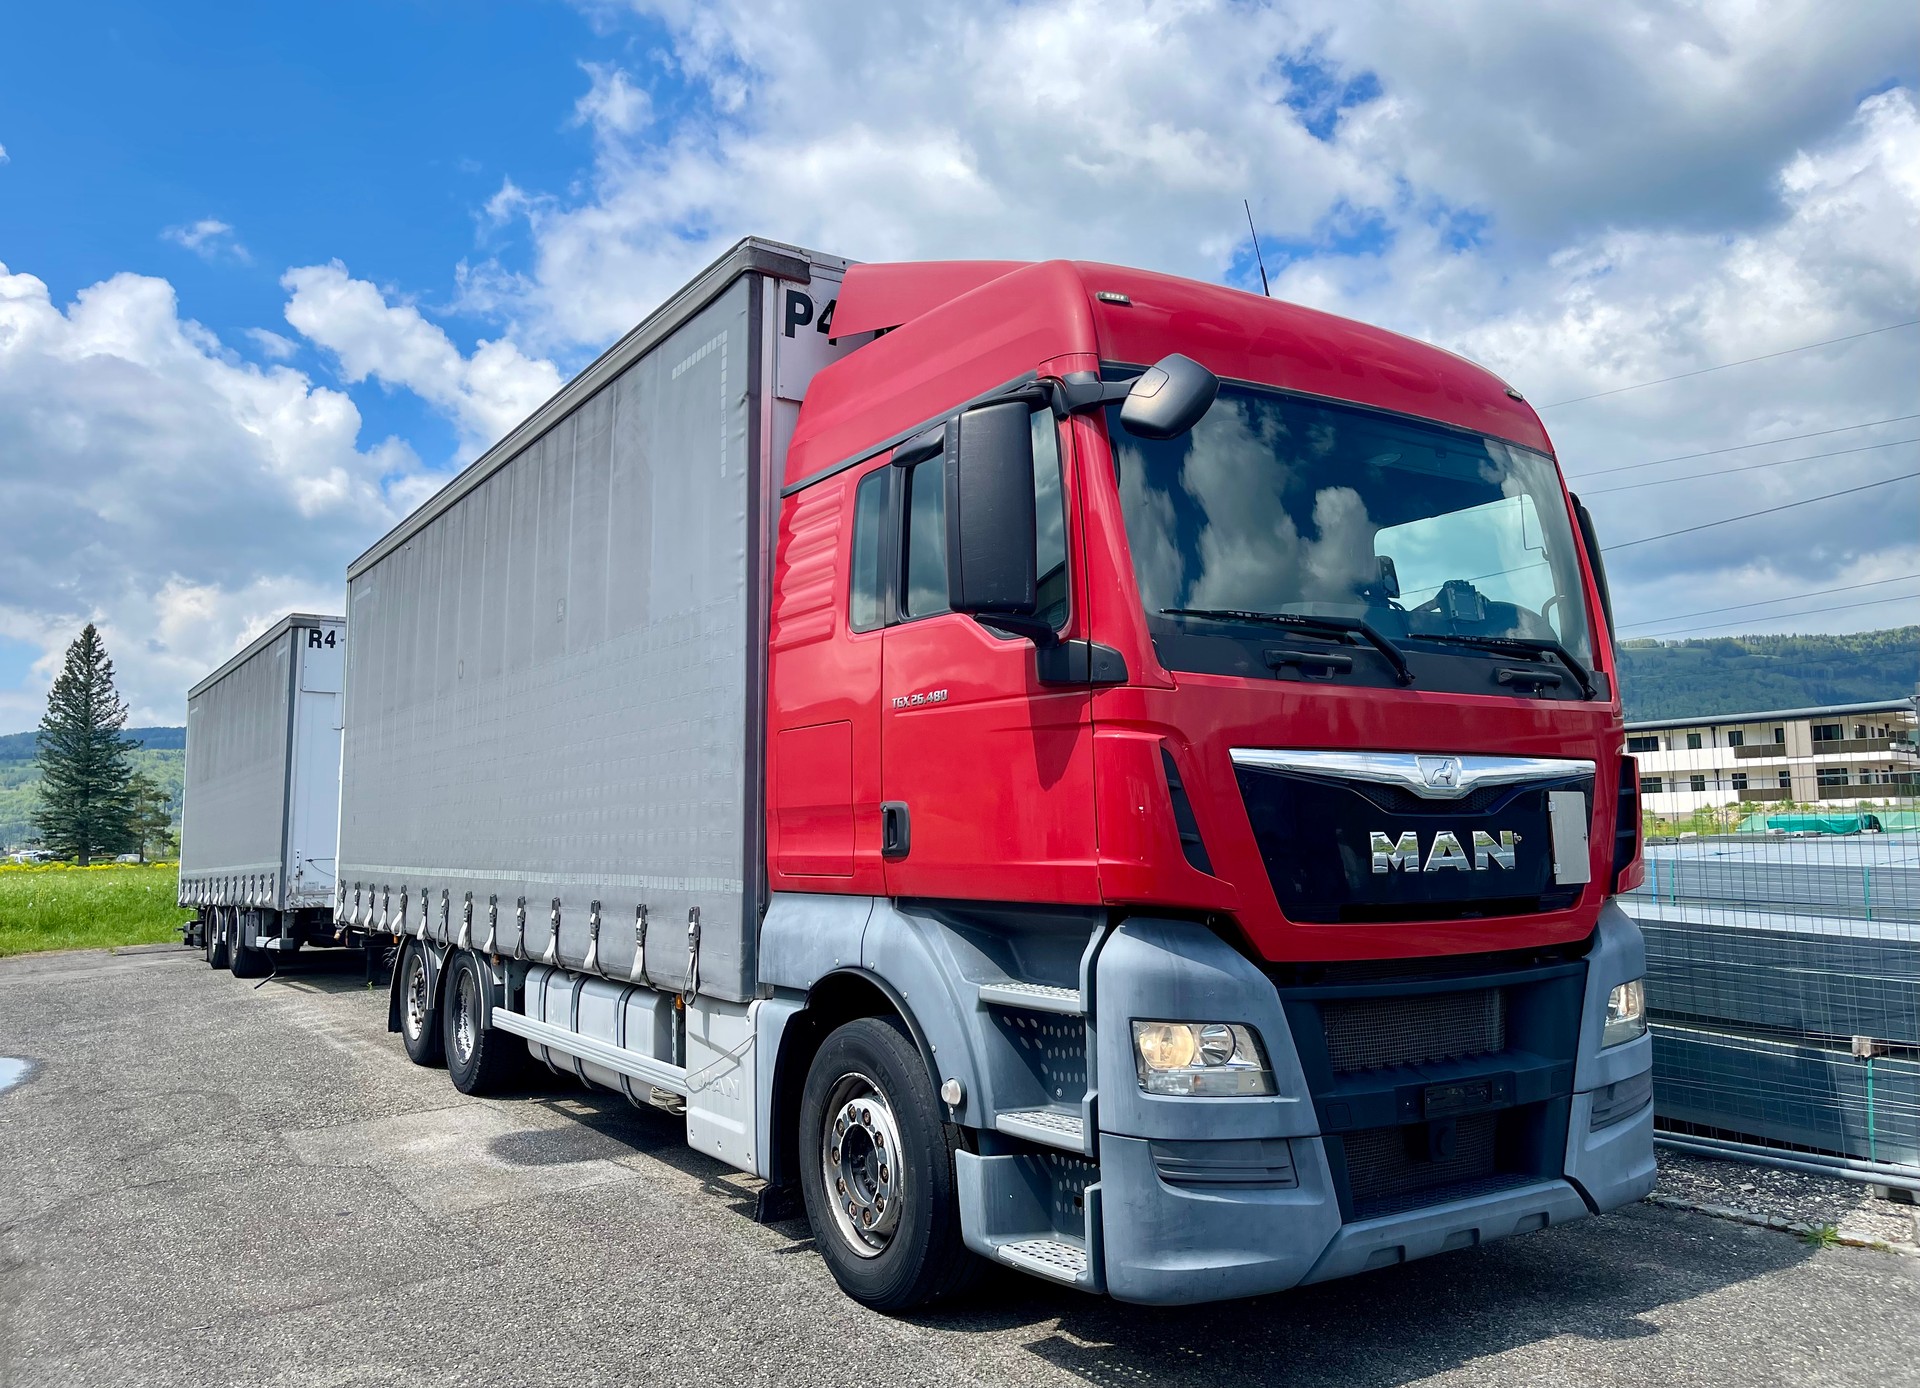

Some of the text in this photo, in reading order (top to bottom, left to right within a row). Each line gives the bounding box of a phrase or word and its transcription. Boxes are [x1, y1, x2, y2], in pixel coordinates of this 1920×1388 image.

[308, 629, 336, 648] R4
[892, 696, 910, 709] TGX
[1369, 830, 1515, 873] MAN
